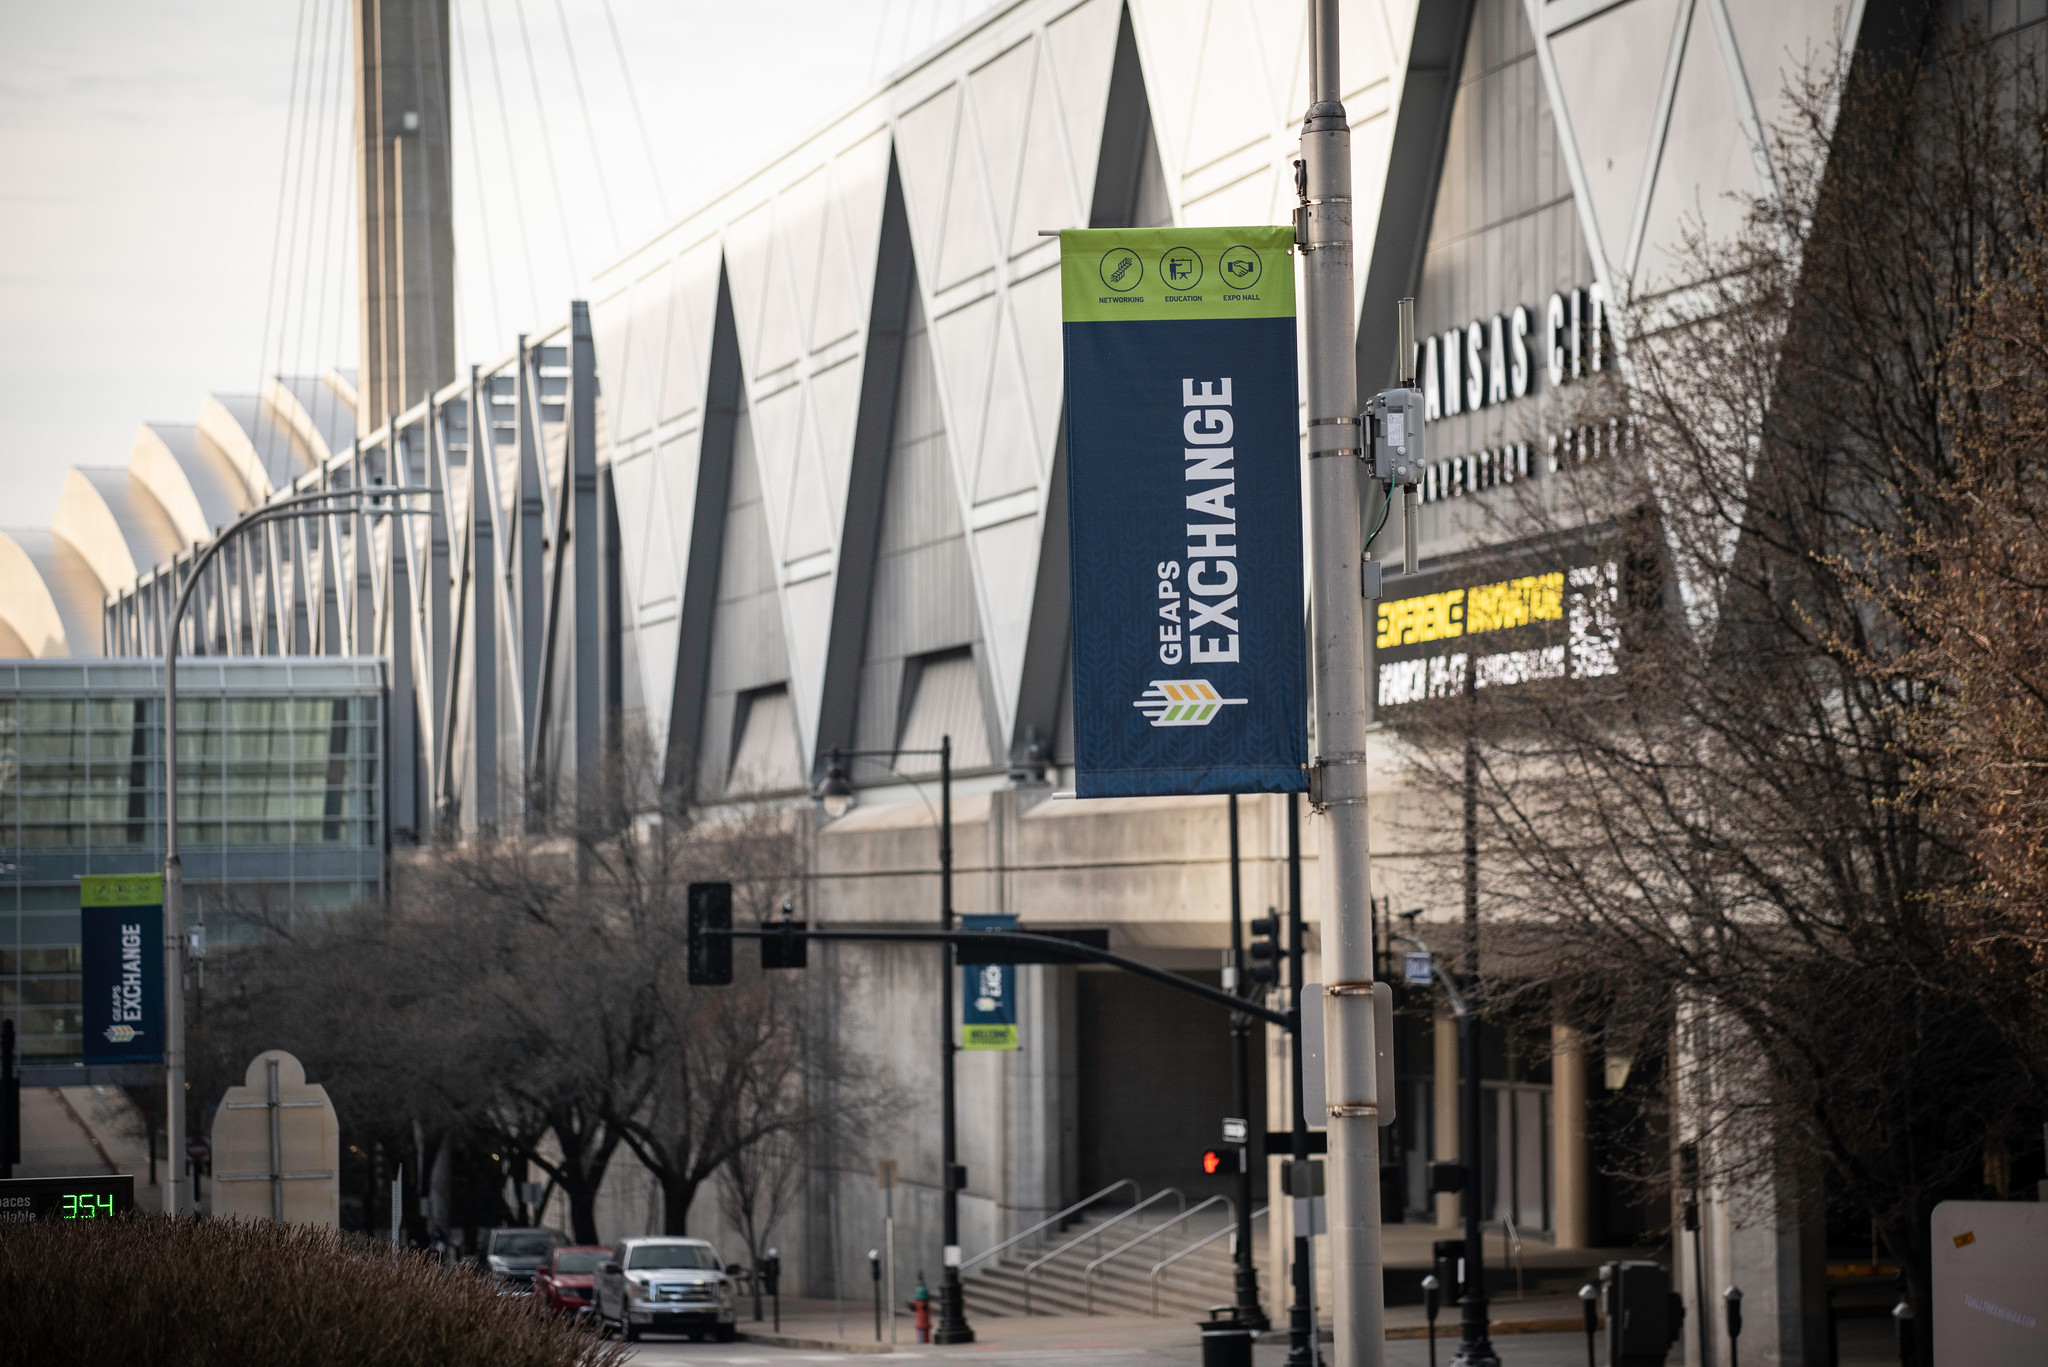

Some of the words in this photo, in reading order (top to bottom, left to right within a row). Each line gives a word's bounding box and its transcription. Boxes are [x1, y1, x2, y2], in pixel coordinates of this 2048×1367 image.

[1098, 296, 1145, 304] NETWORKING
[1165, 295, 1203, 303] EDUCATION
[1414, 304, 1528, 423] ANSAS
[1547, 282, 1606, 388] CIT
[1183, 377, 1240, 664] EXCHANGE
[1157, 560, 1183, 665] GEAPS
[121, 923, 142, 1021] EXCHANGE
[112, 985, 122, 1022] GEAPS
[0, 1209, 36, 1223] ilable
[62, 1194, 113, 1219] 354
